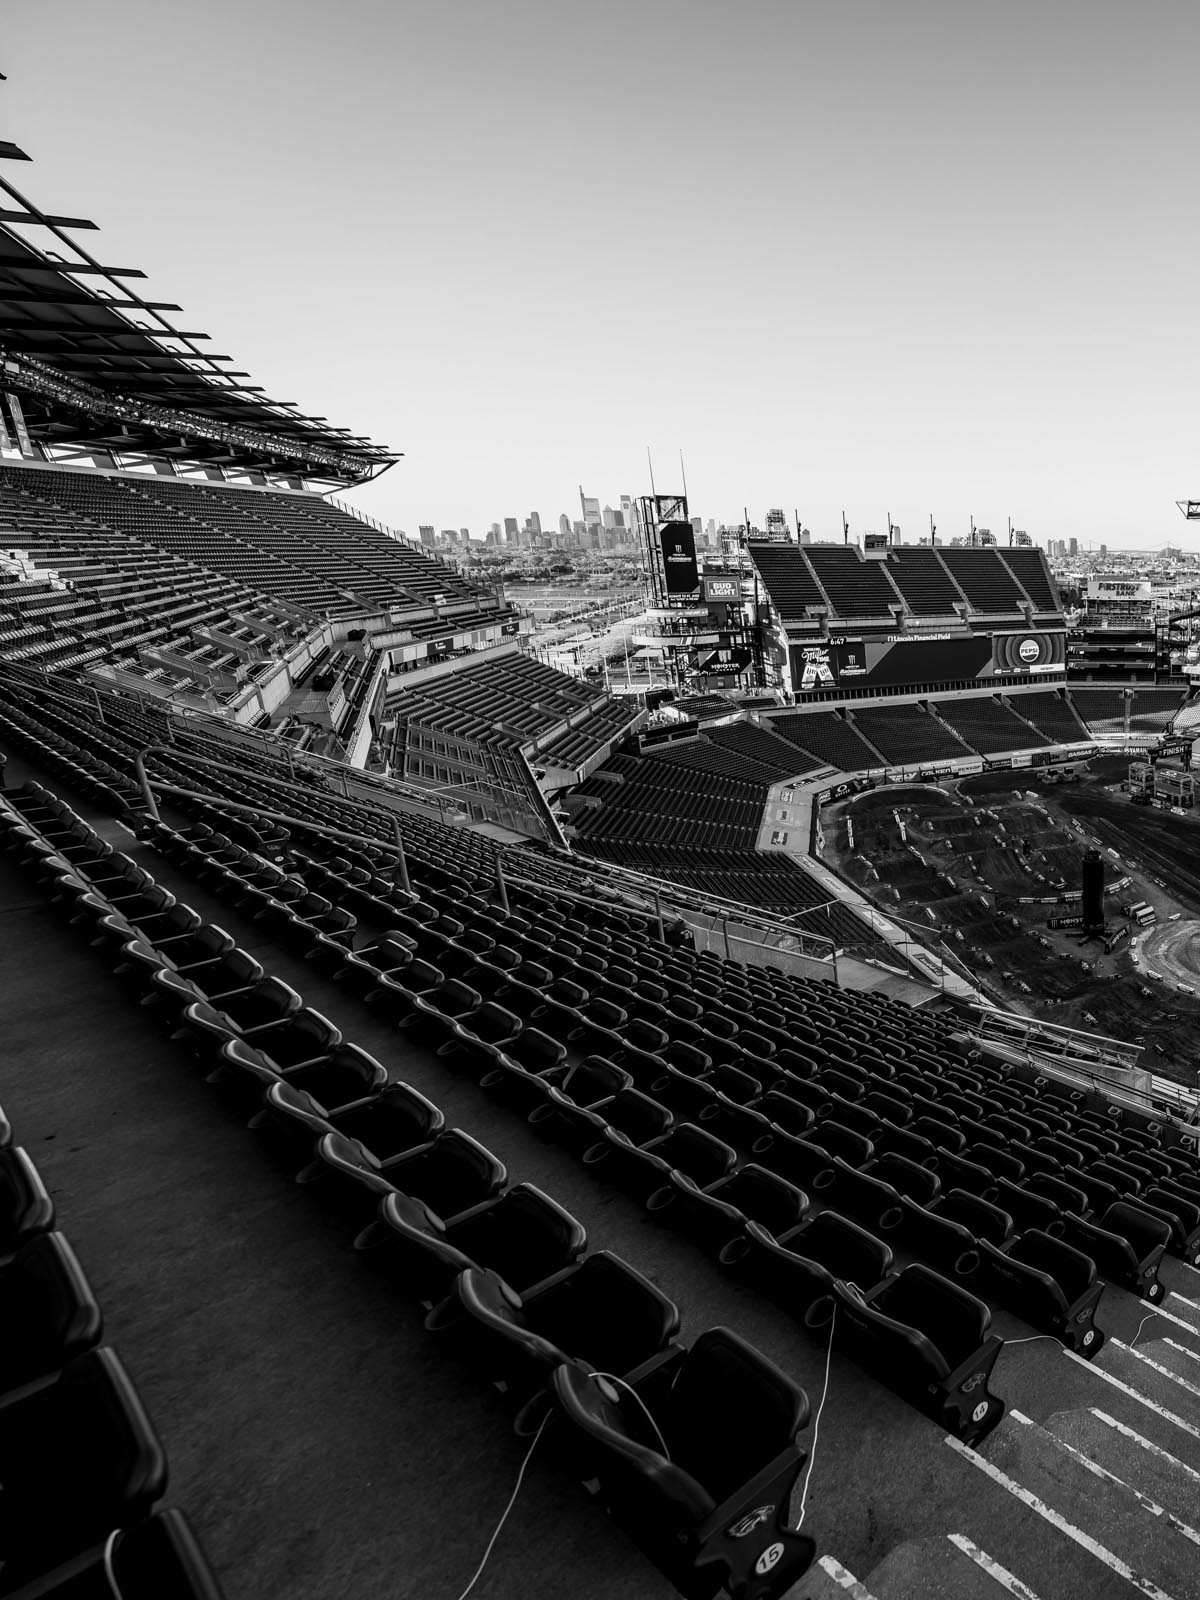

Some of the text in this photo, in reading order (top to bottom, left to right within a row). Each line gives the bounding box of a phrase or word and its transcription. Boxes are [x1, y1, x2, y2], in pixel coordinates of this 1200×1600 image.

[1098, 582, 1142, 591] FIRSTRUST
[710, 588, 736, 596] LIGHT
[893, 634, 914, 642] Lincoln
[914, 633, 937, 641] Financial
[801, 648, 829, 662] Miller
[1068, 749, 1092, 758] GASGAS
[1163, 745, 1184, 757] FINISH
[921, 767, 951, 777] FALKEN
[1060, 917, 1084, 925] MONST
[974, 1404, 985, 1419] 14
[759, 1546, 779, 1569] 15
